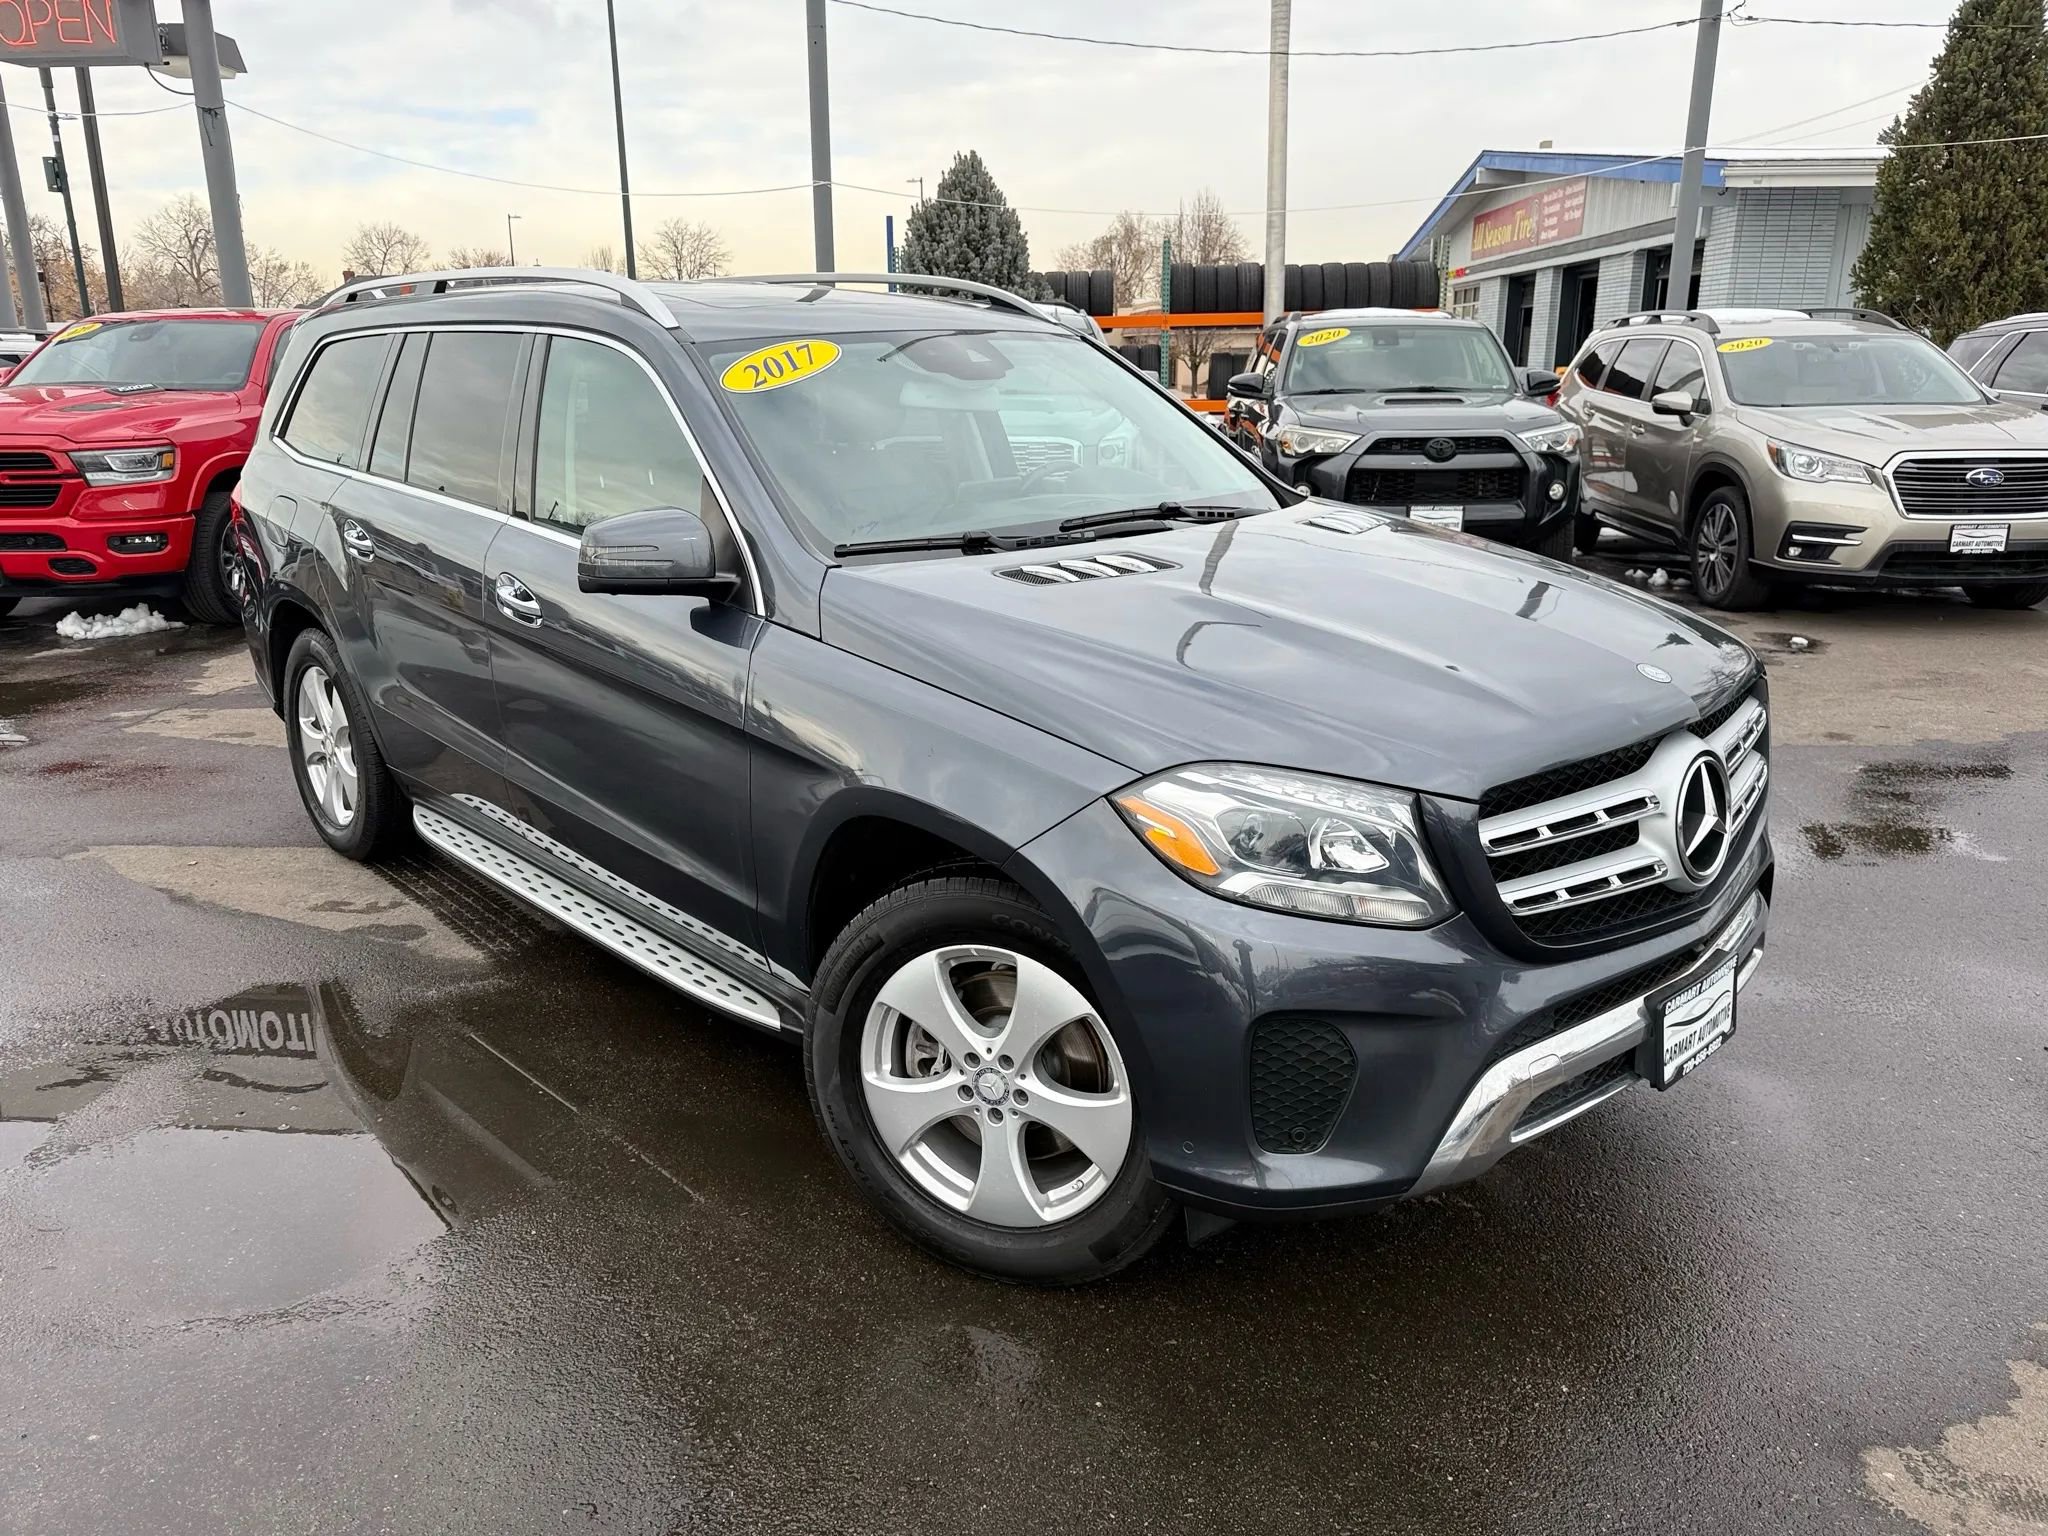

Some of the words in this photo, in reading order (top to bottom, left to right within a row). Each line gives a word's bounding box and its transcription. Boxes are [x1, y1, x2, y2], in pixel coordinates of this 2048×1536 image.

[0, 0, 116, 45] OPEN
[1513, 209, 1533, 241] Tire
[1306, 330, 1341, 344] 2020
[1728, 339, 1763, 351] 2020
[743, 344, 814, 388] 2017
[1665, 983, 1702, 1015] CARMART
[1700, 955, 1738, 993] AUTOMOTIVE
[1664, 1032, 1698, 1066] CARMART
[1697, 1002, 1732, 1042] AUTOMOTIVE
